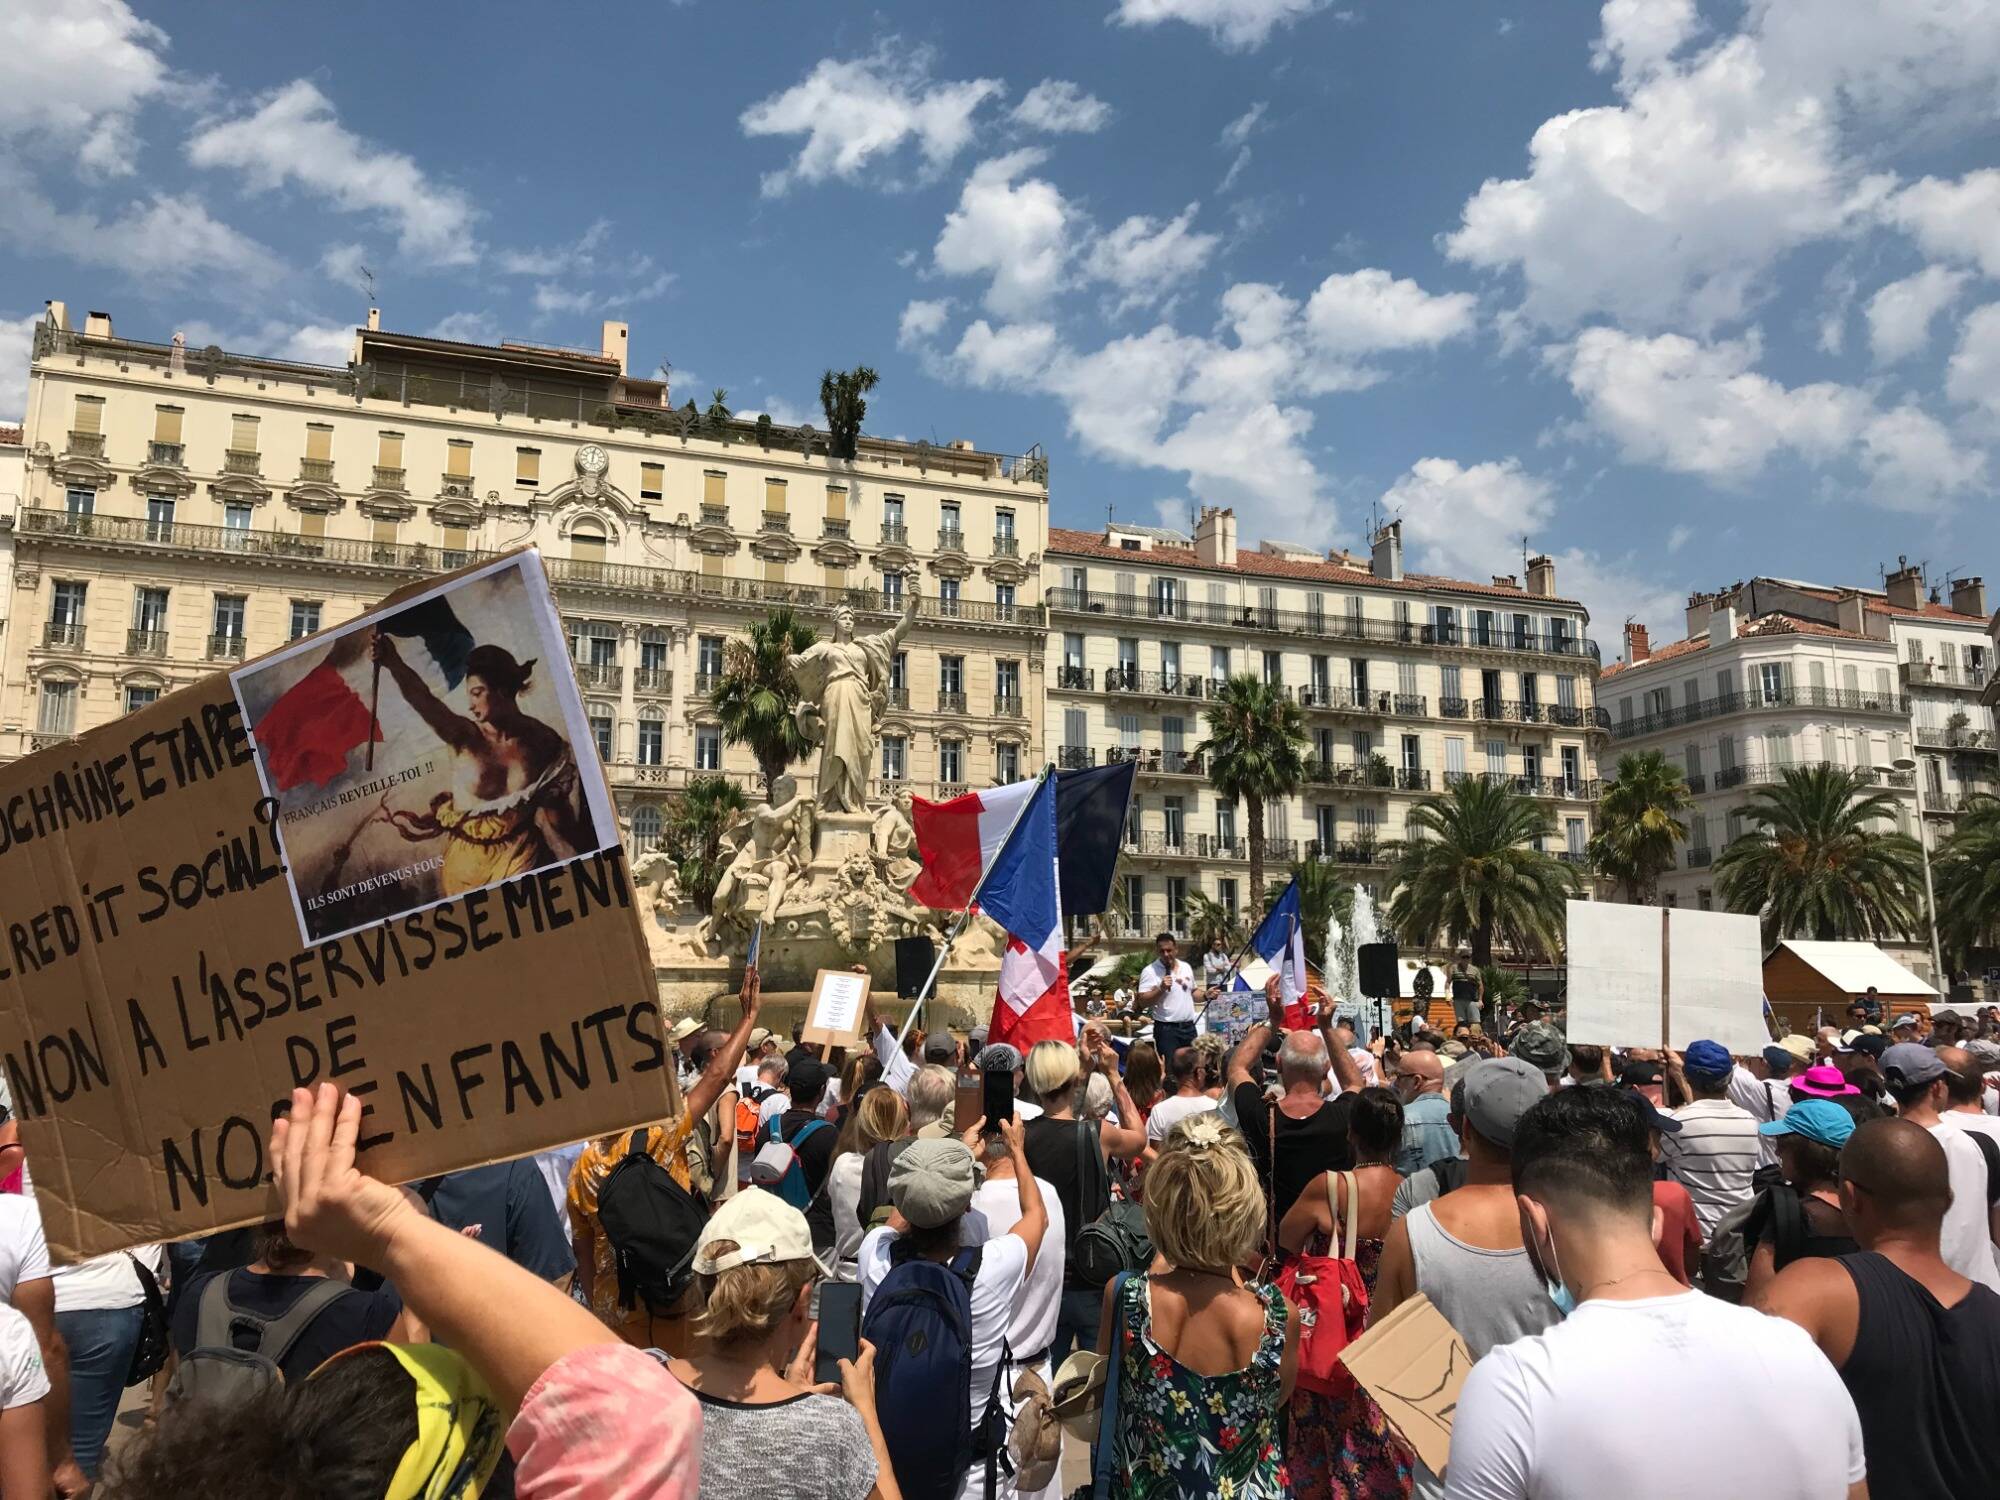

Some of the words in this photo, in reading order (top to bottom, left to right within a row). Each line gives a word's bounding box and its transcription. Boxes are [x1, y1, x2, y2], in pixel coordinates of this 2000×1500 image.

[283, 797, 338, 825] FRANÇAIS
[339, 766, 421, 805] REVEILLE-TOI
[307, 895, 326, 911] ILS
[326, 885, 356, 904] SONT
[358, 866, 412, 894] DEVENUS
[413, 855, 446, 875] FOUS
[0, 884, 124, 980] REDiT
[5, 1001, 109, 1120] NON
[127, 998, 167, 1076] A
[286, 1015, 366, 1088] DE
